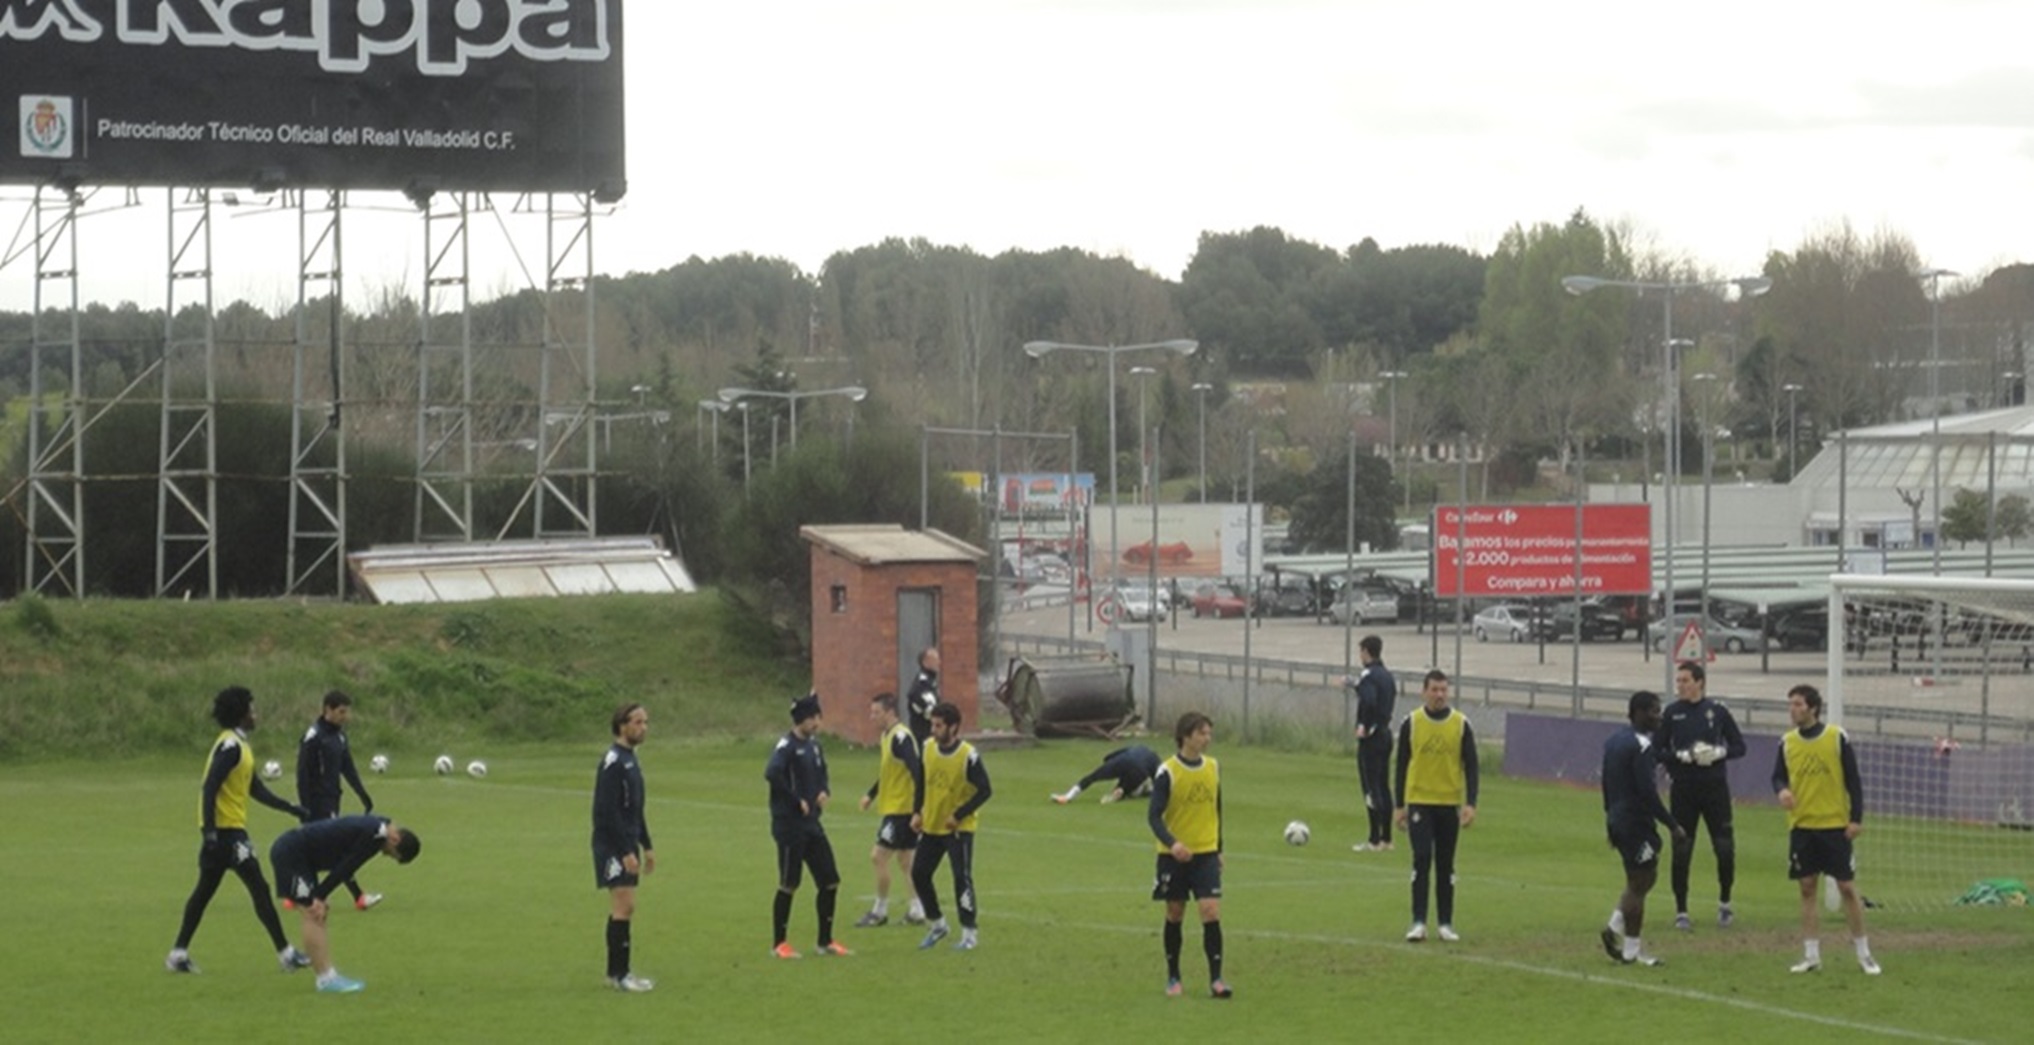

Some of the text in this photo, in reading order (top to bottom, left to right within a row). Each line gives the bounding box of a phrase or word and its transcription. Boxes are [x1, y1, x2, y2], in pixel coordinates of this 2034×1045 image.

[97, 118, 516, 151] Patrocinador Técnico Oficial del Real Valladolid C.F.
[1445, 511, 1495, 523] Carefour
[1522, 536, 1564, 549] precios
[1465, 550, 1509, 566] 2.000
[1576, 552, 1637, 564] limentación
[1487, 574, 1603, 591] Compara y ahrra
